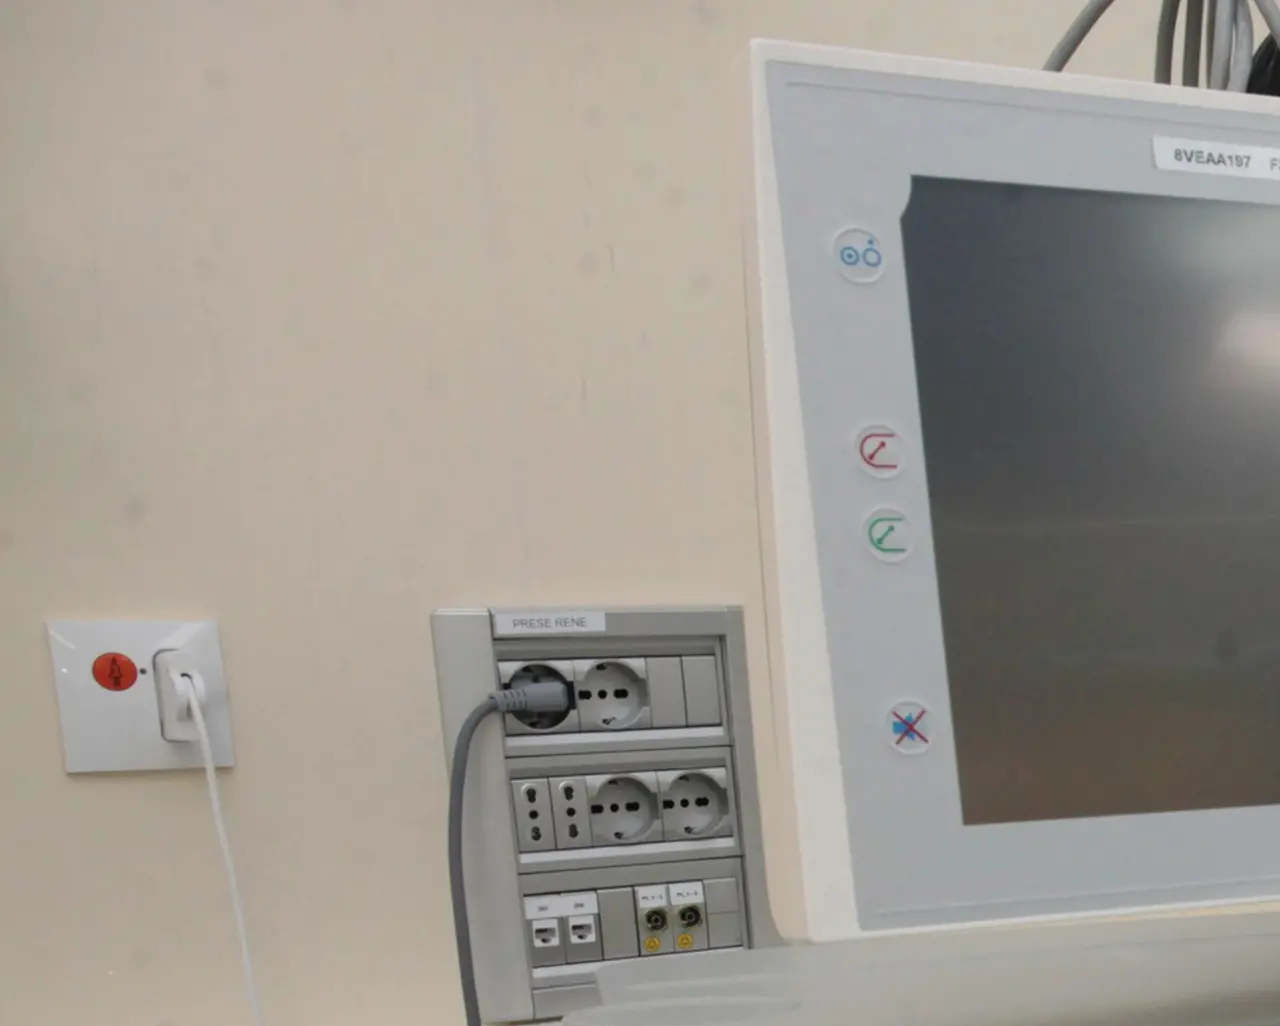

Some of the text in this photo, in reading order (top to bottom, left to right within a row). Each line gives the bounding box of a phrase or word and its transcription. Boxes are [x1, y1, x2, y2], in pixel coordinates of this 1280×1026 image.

[1173, 148, 1252, 169] 8VEAA197
[512, 616, 588, 629] PRESE RENE
